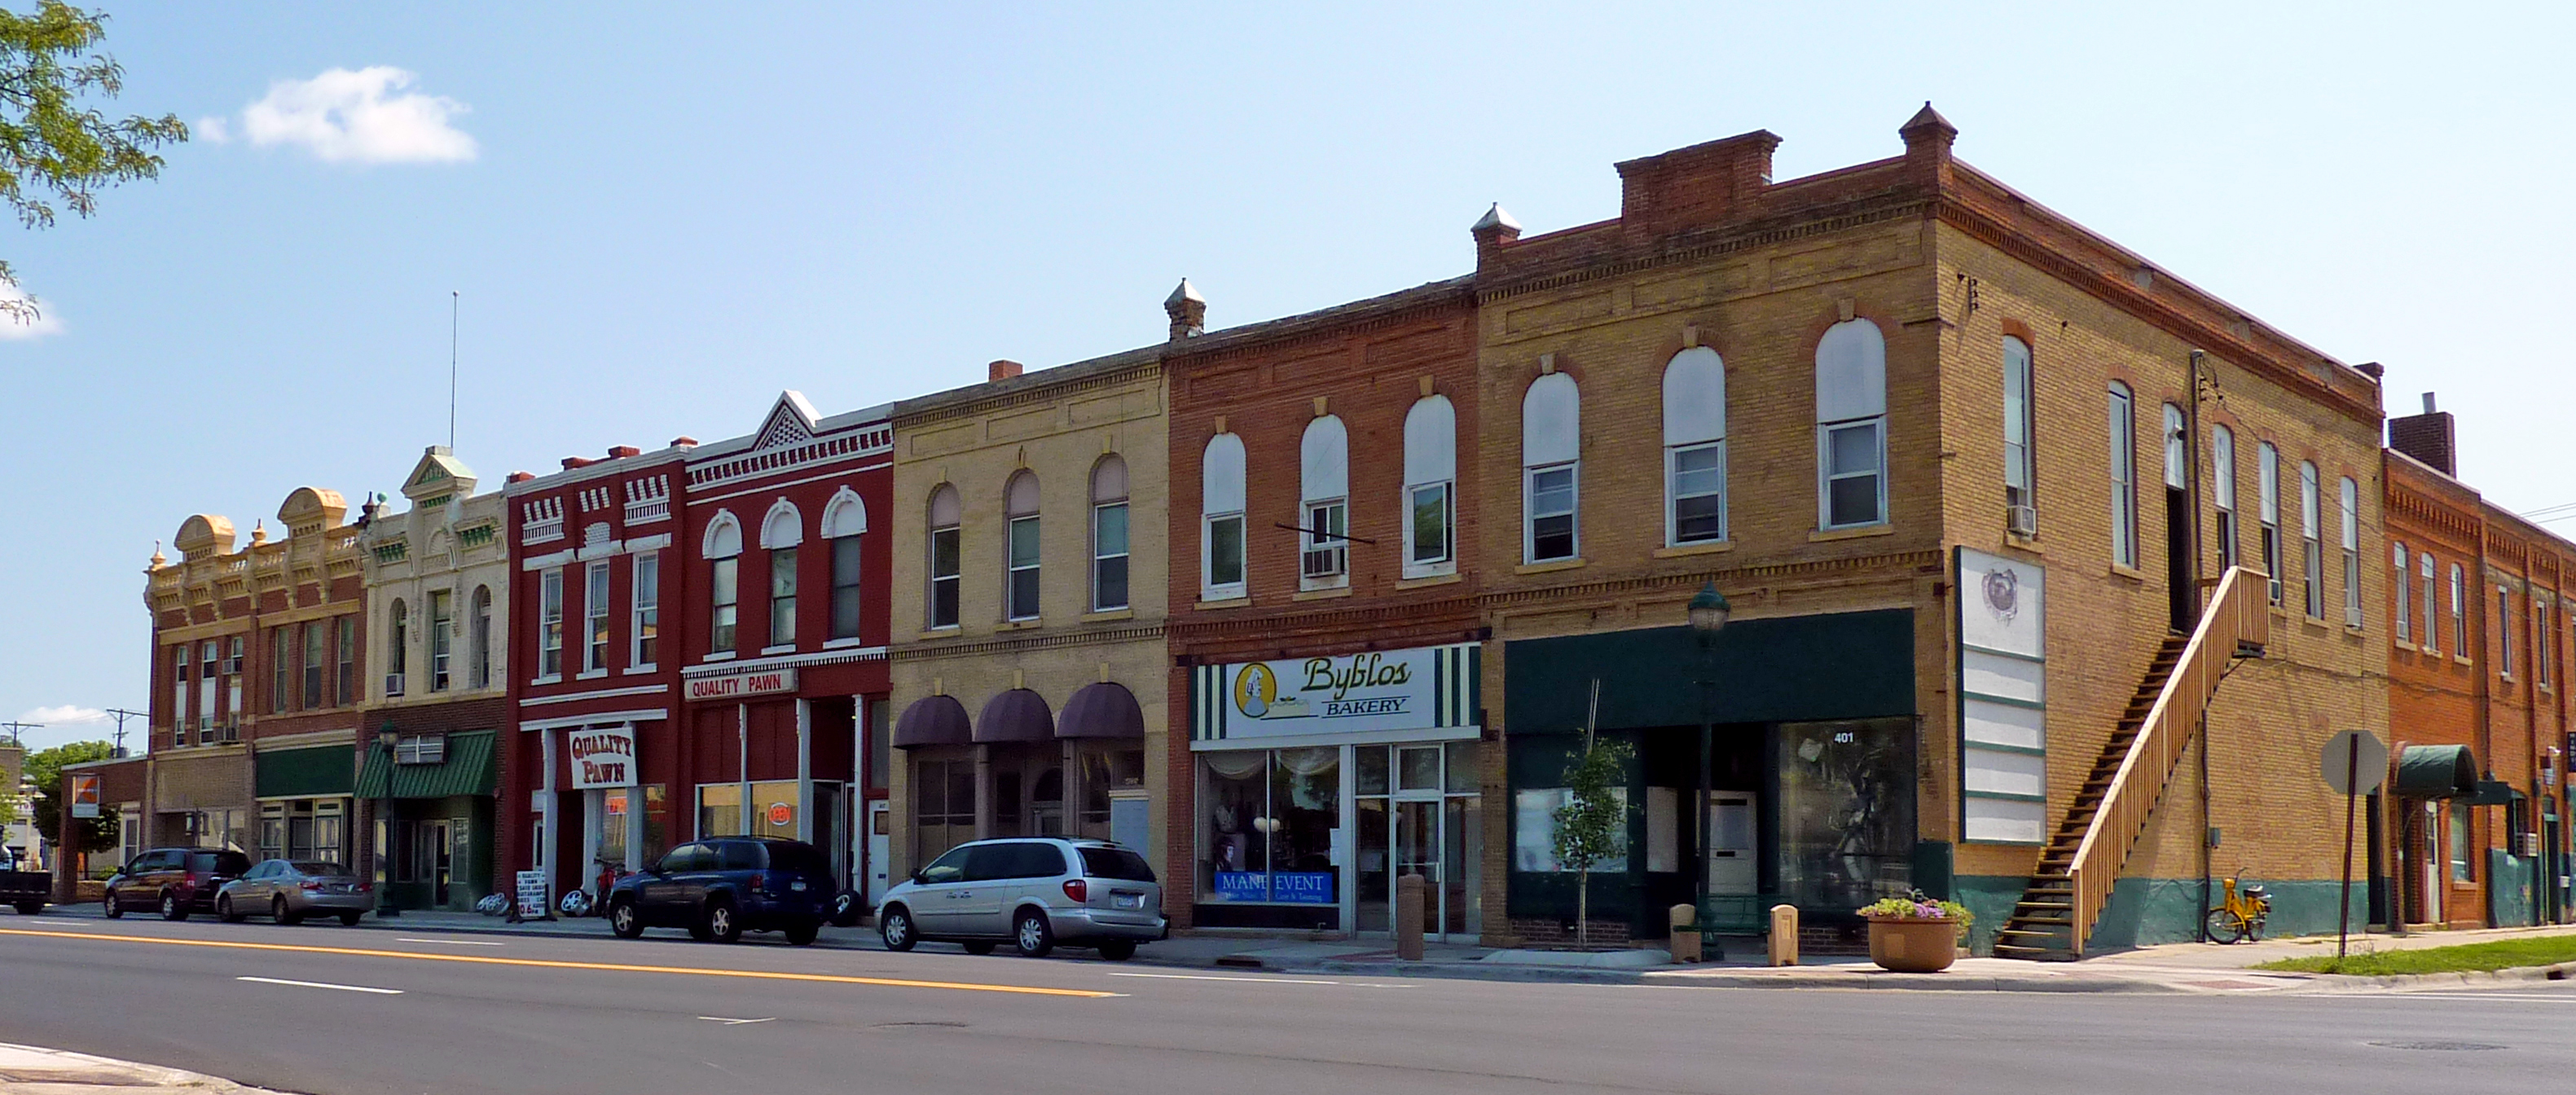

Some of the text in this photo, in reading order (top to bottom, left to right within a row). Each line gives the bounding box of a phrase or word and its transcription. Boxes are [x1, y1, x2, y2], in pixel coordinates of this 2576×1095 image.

[692, 674, 781, 697] QUALITY PAWN
[1300, 653, 1412, 701] Byblos
[1327, 698, 1407, 715] BAKERY
[572, 734, 631, 760] QUALITY
[1834, 732, 1853, 744] 401
[582, 760, 625, 784] PAWN
[1223, 875, 1324, 891] MANE EVENT
